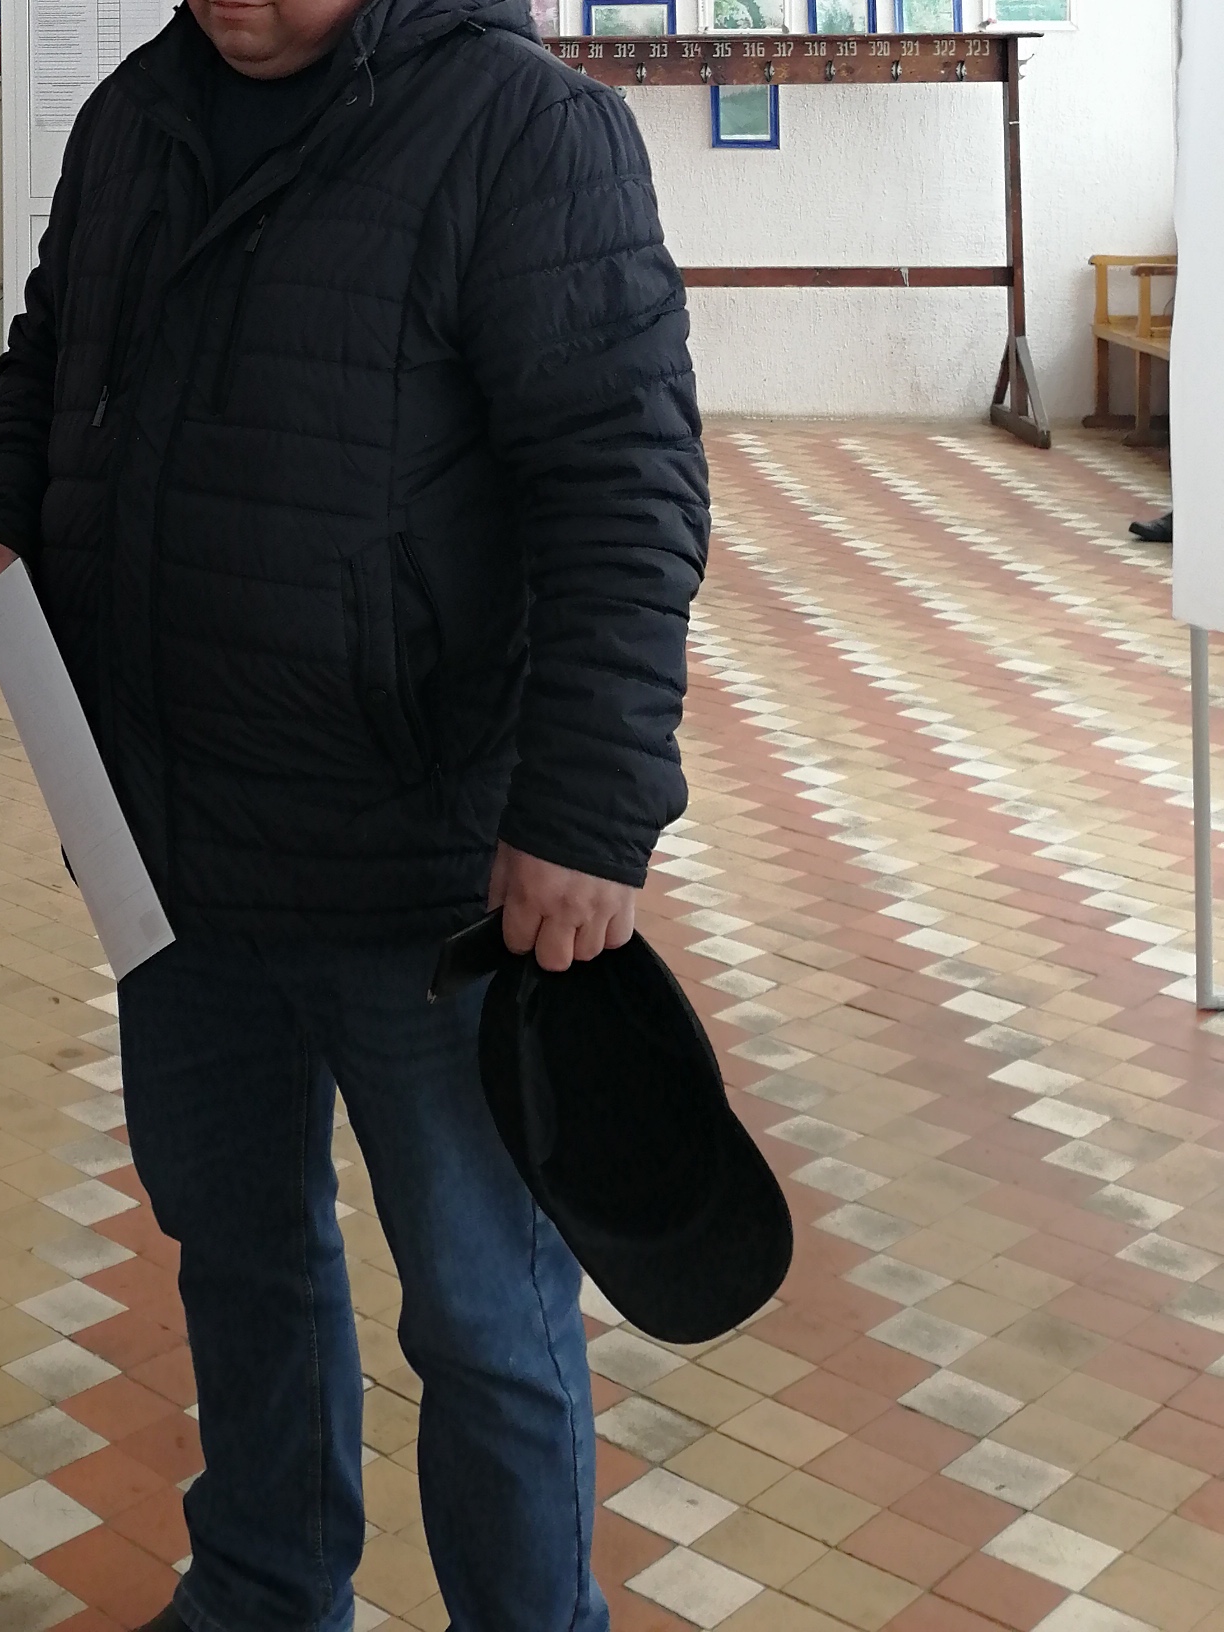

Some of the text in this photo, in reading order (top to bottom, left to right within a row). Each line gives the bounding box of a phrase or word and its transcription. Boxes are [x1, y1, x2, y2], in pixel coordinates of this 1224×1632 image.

[558, 43, 579, 58] 310
[587, 43, 603, 58] 311
[613, 43, 635, 58] 312
[649, 43, 668, 58] 313
[681, 42, 702, 58] 314
[712, 42, 732, 58] 315
[742, 42, 765, 58] 316
[772, 41, 794, 57] 317
[804, 41, 826, 57] 318
[836, 41, 857, 57] 319
[868, 41, 890, 56] 320
[900, 41, 920, 56] 321
[932, 40, 955, 56] 322
[965, 39, 989, 56] 323
